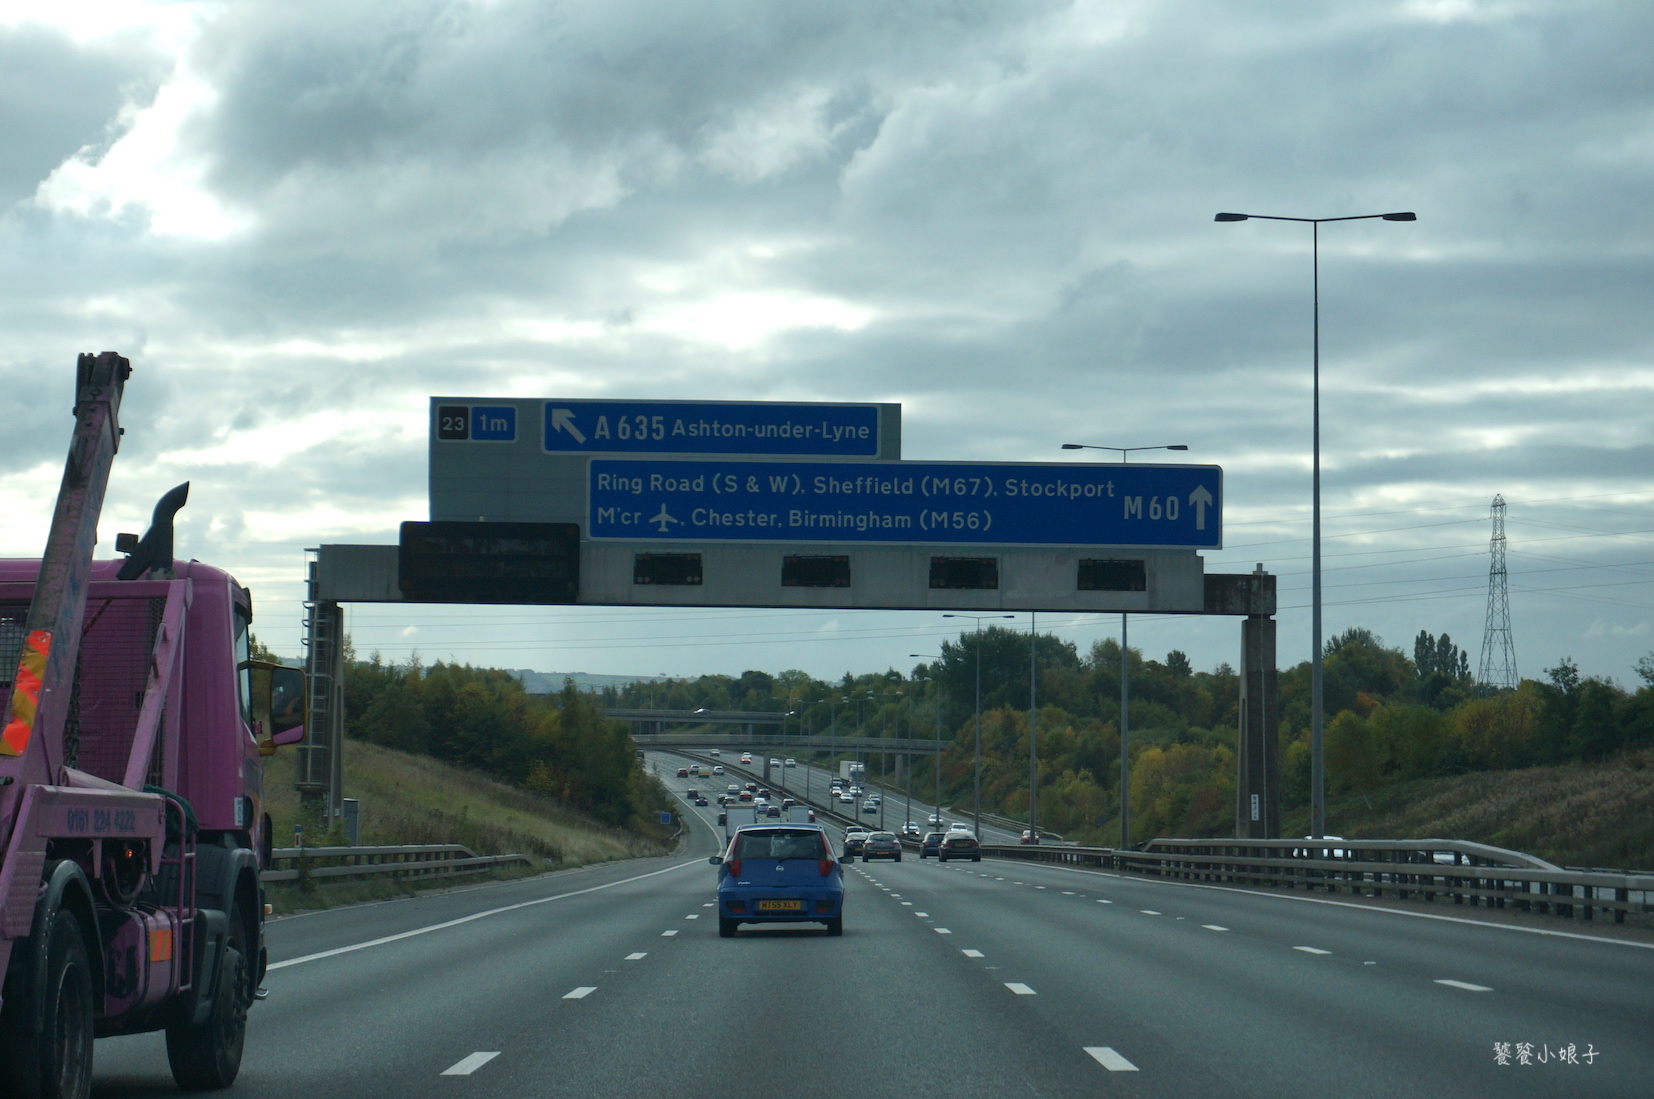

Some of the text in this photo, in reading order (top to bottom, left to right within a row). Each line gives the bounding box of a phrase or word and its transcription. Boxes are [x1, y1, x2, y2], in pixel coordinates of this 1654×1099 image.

[442, 416, 465, 432] 23
[479, 414, 507, 432] 1m
[671, 418, 870, 442] Ashton-under-Lyne
[597, 473, 643, 495] Ring
[650, 474, 704, 492] Road
[712, 472, 739, 494] (S
[746, 475, 760, 493] &
[813, 476, 913, 495] Sheffield
[921, 475, 998, 498] (M67),
[1005, 479, 1115, 500] Stockport
[691, 508, 783, 528] Chester,
[789, 510, 912, 532] Birmingham
[919, 509, 992, 532] (M56)
[67, 808, 89, 831] 0161
